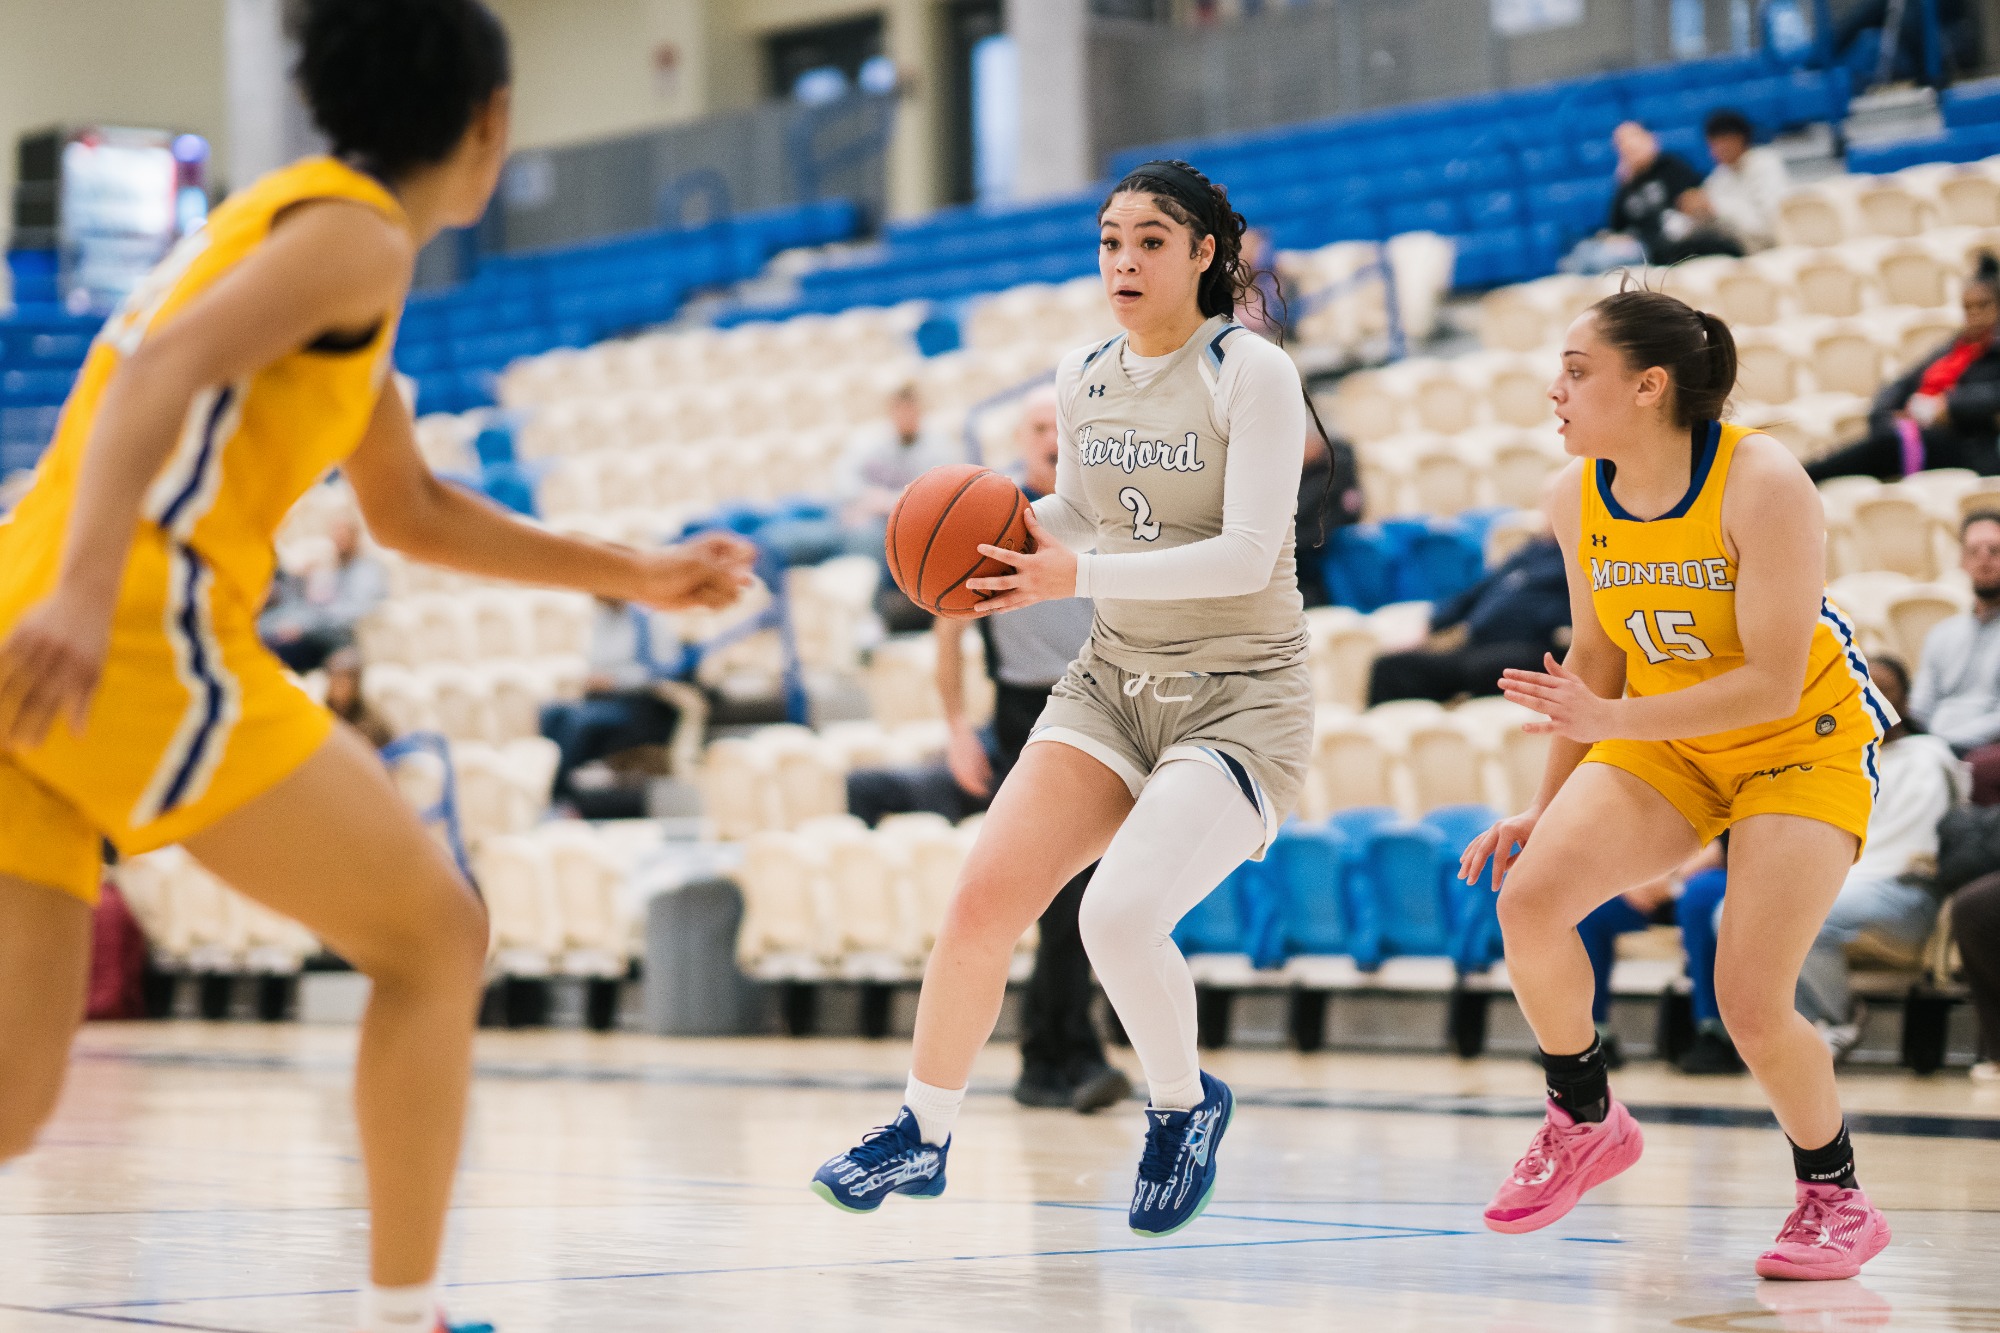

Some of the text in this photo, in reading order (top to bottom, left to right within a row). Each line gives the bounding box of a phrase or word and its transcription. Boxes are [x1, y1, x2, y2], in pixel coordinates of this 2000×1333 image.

[1118, 486, 1162, 542] 2
[1590, 557, 1735, 592] MONROE
[1624, 610, 1714, 665] 15
